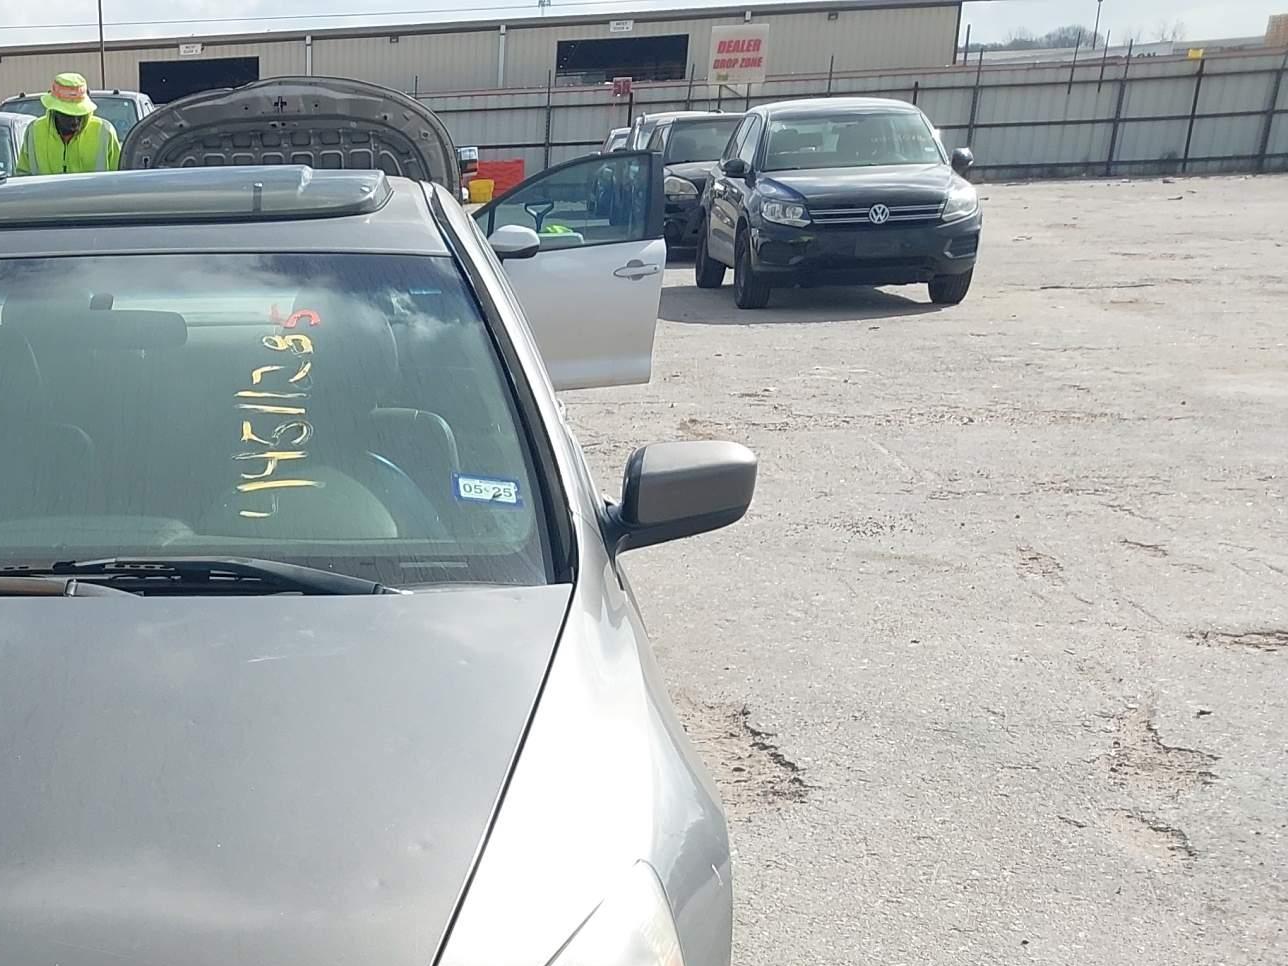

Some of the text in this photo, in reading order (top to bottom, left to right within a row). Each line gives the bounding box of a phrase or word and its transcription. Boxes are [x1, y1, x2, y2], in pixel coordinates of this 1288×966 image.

[717, 39, 762, 54] DEALER
[713, 56, 763, 69] DROP ZONE
